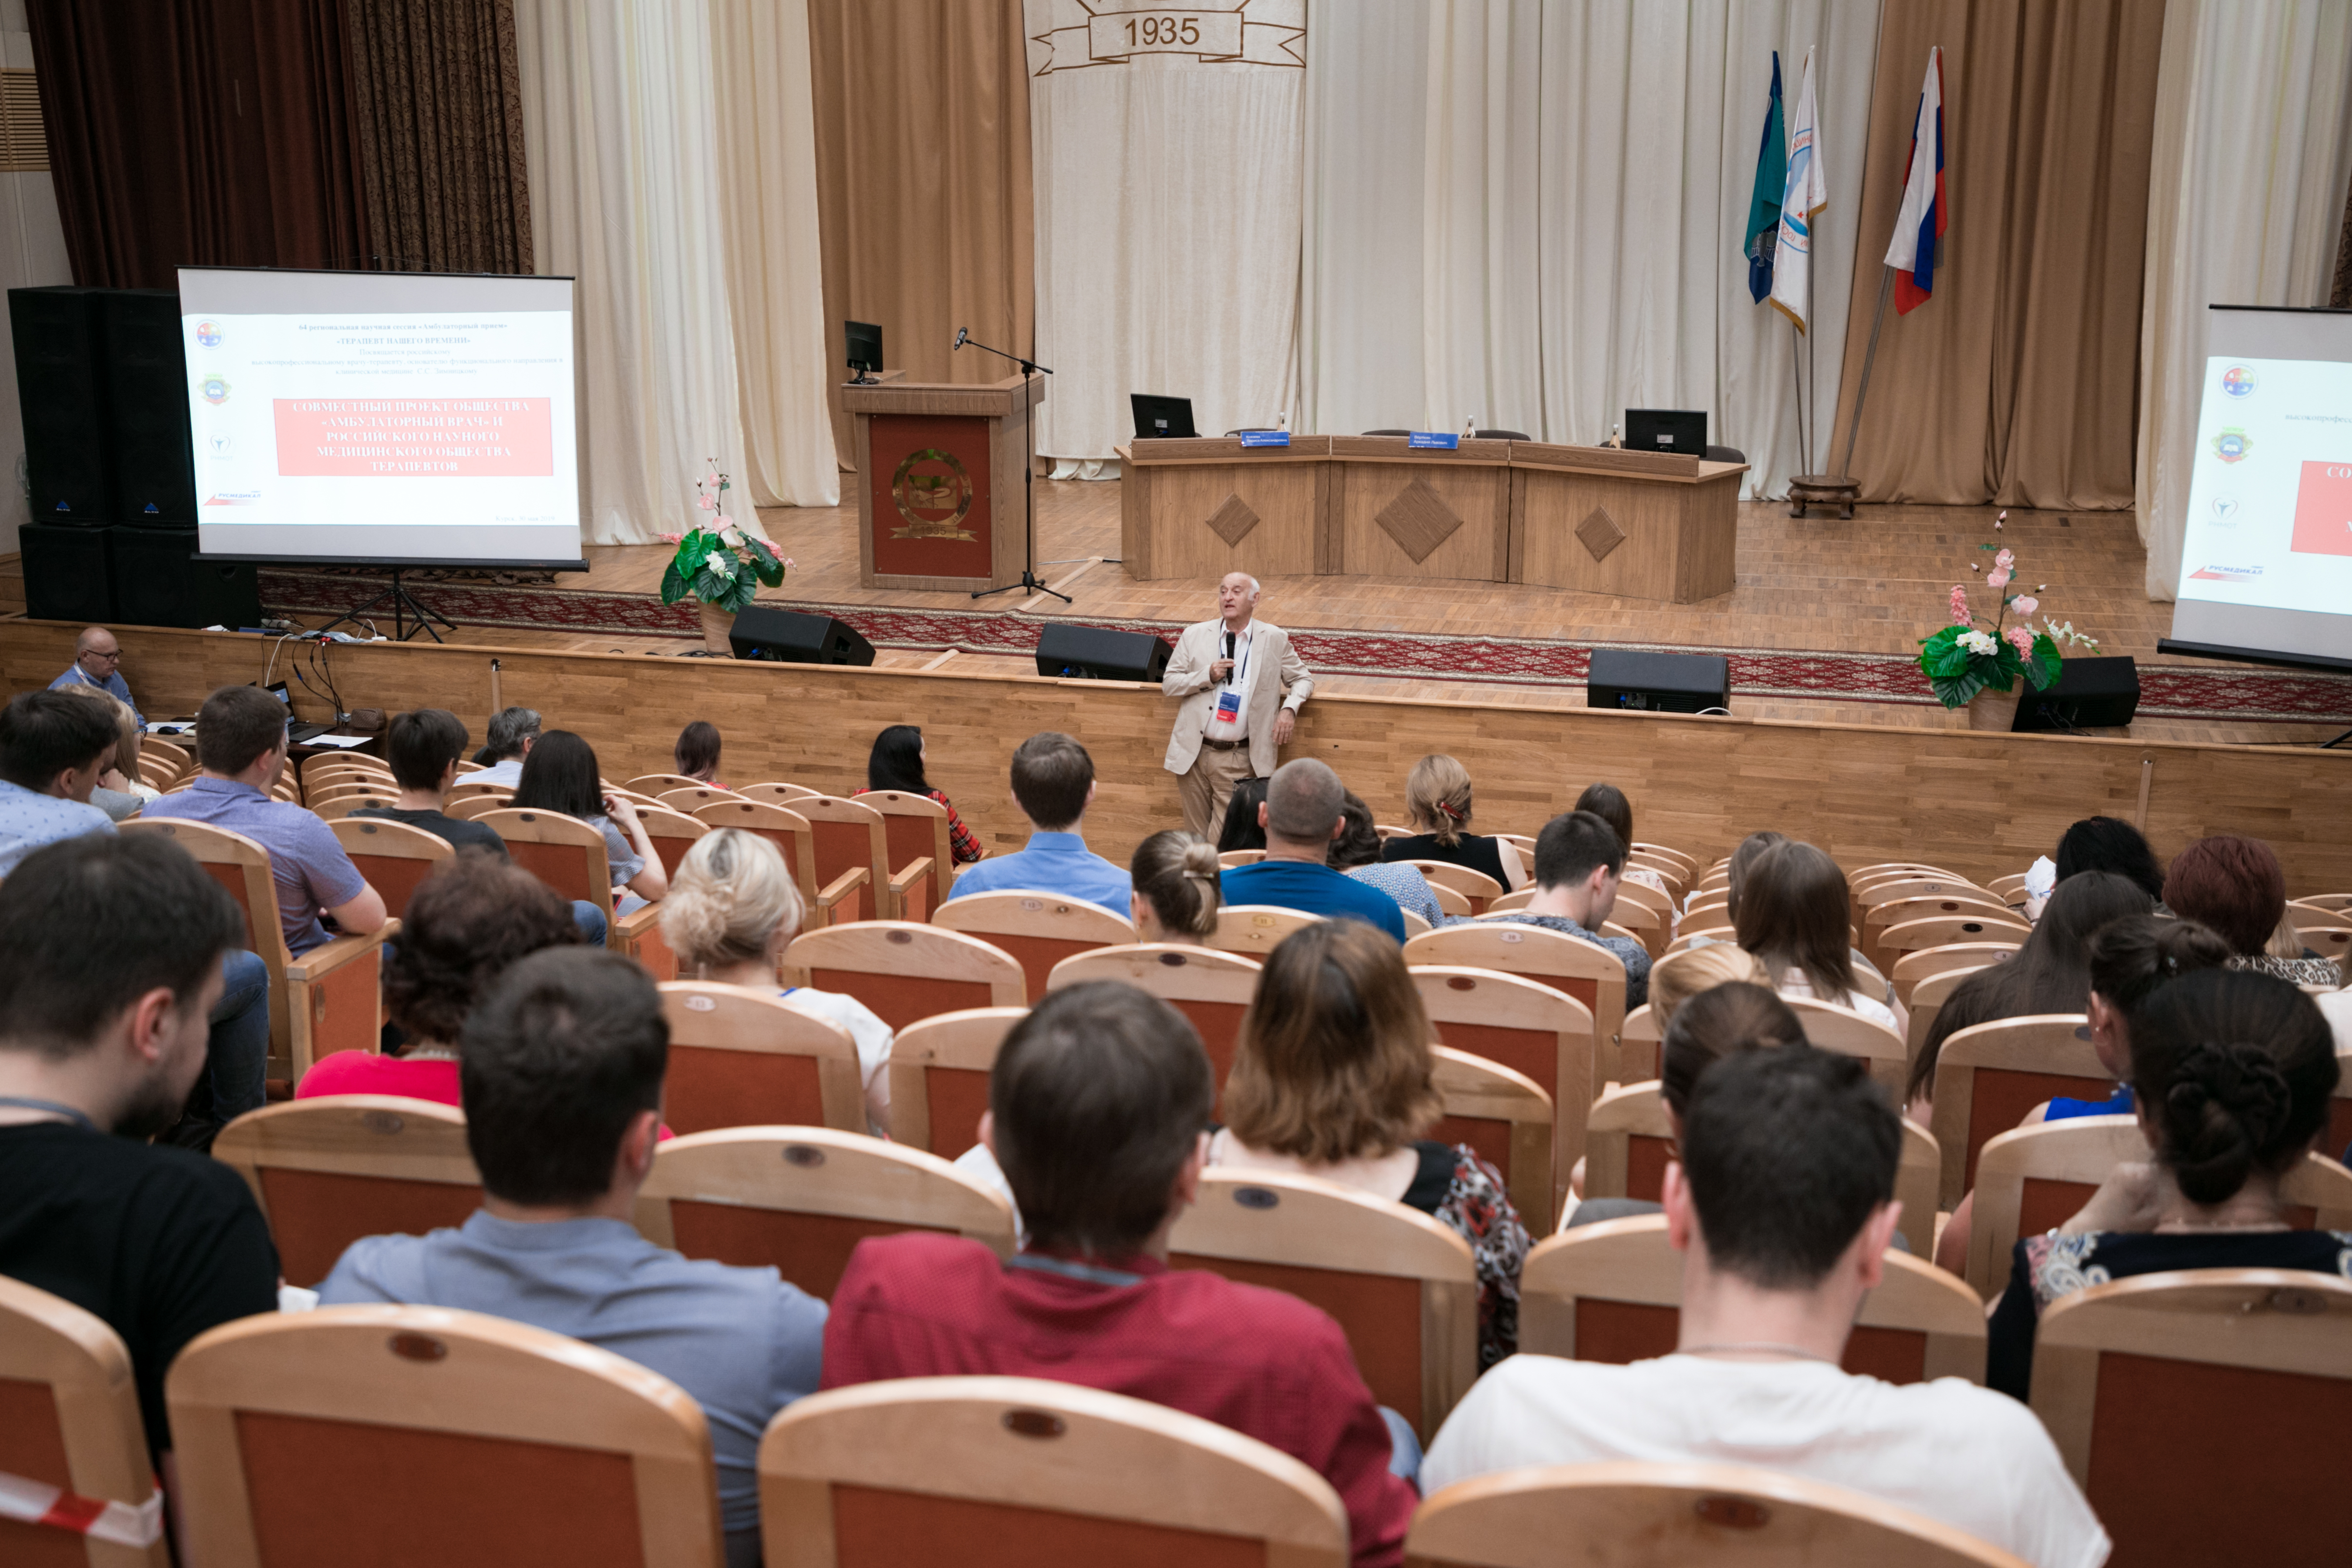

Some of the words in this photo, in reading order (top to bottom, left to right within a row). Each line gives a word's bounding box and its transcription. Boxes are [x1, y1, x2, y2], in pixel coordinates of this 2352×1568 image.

[1125, 17, 1200, 46] 1935
[418, 323, 478, 331] «Амбулаторный
[293, 400, 392, 412] СОВМЕСТНЫЙ
[395, 402, 450, 412] ПРОЕКТ
[452, 402, 529, 413] ОБЩЕСТВА
[321, 416, 444, 427] «АМБУЛАТОРНЫЙ
[446, 417, 489, 427] ВРАЧ»
[492, 417, 502, 427] И
[327, 430, 429, 442] РОССИЙСКОГО
[433, 432, 499, 442] НАУНОГО
[317, 446, 432, 458] МЕДИЦИНСКОГО
[435, 447, 511, 458] ОБЩЕСТВА
[370, 461, 458, 472] ТЕРАПЕВТОВ
[921, 526, 946, 535] 1935
[2208, 521, 2238, 530] РНМОТ
[2209, 565, 2263, 575] РУСМЕДИКАЛ
